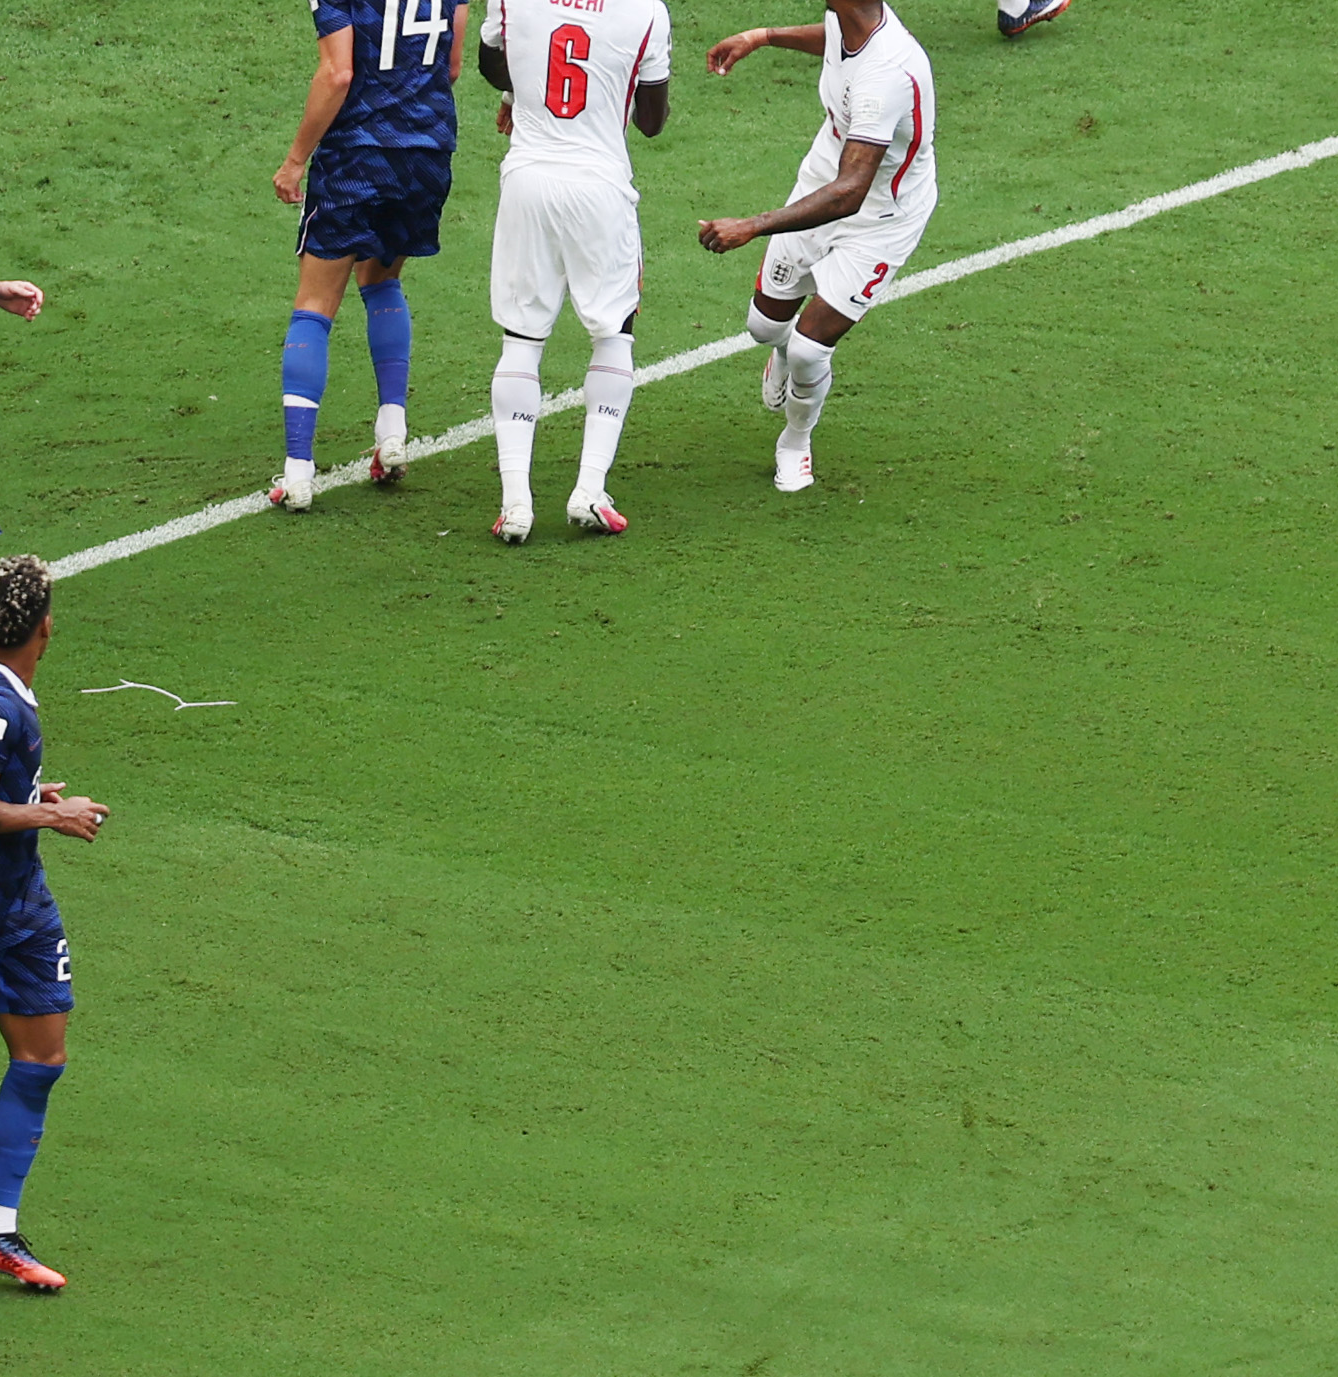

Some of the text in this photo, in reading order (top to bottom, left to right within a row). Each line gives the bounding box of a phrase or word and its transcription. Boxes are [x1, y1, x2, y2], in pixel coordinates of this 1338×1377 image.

[545, 23, 591, 119] 6
[861, 262, 889, 299] 2
[512, 412, 536, 423] ENG
[598, 404, 621, 418] ENG
